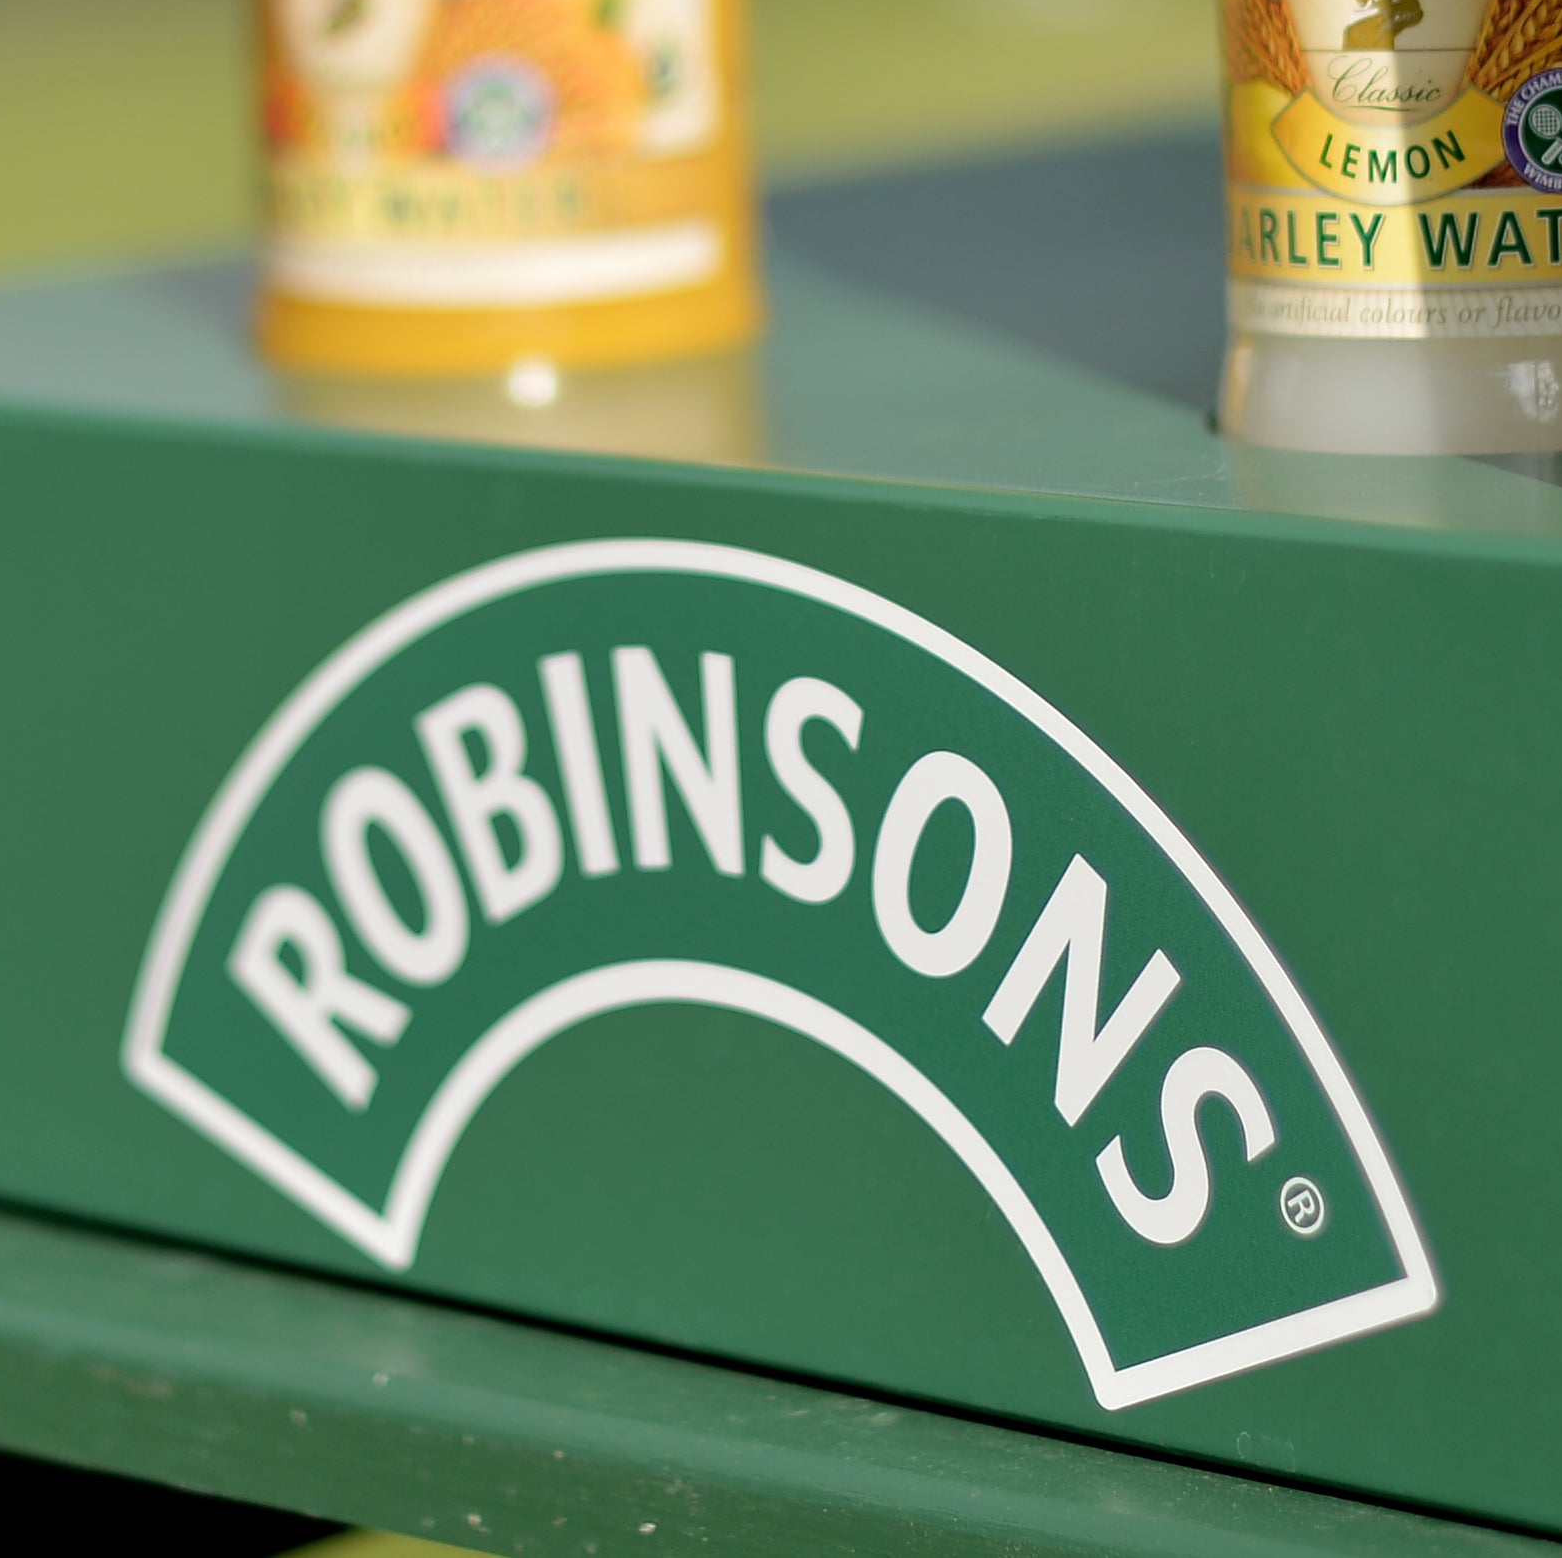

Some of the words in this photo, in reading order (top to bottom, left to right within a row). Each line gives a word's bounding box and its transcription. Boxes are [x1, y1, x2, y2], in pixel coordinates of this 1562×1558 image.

[1328, 55, 1442, 103] Classic
[1507, 99, 1525, 125] THE
[1319, 128, 1466, 184] LEMON
[1270, 295, 1352, 328] artificial
[1360, 298, 1448, 325] colours
[1458, 307, 1487, 324] or
[227, 646, 1276, 1247] ROBINSONS
